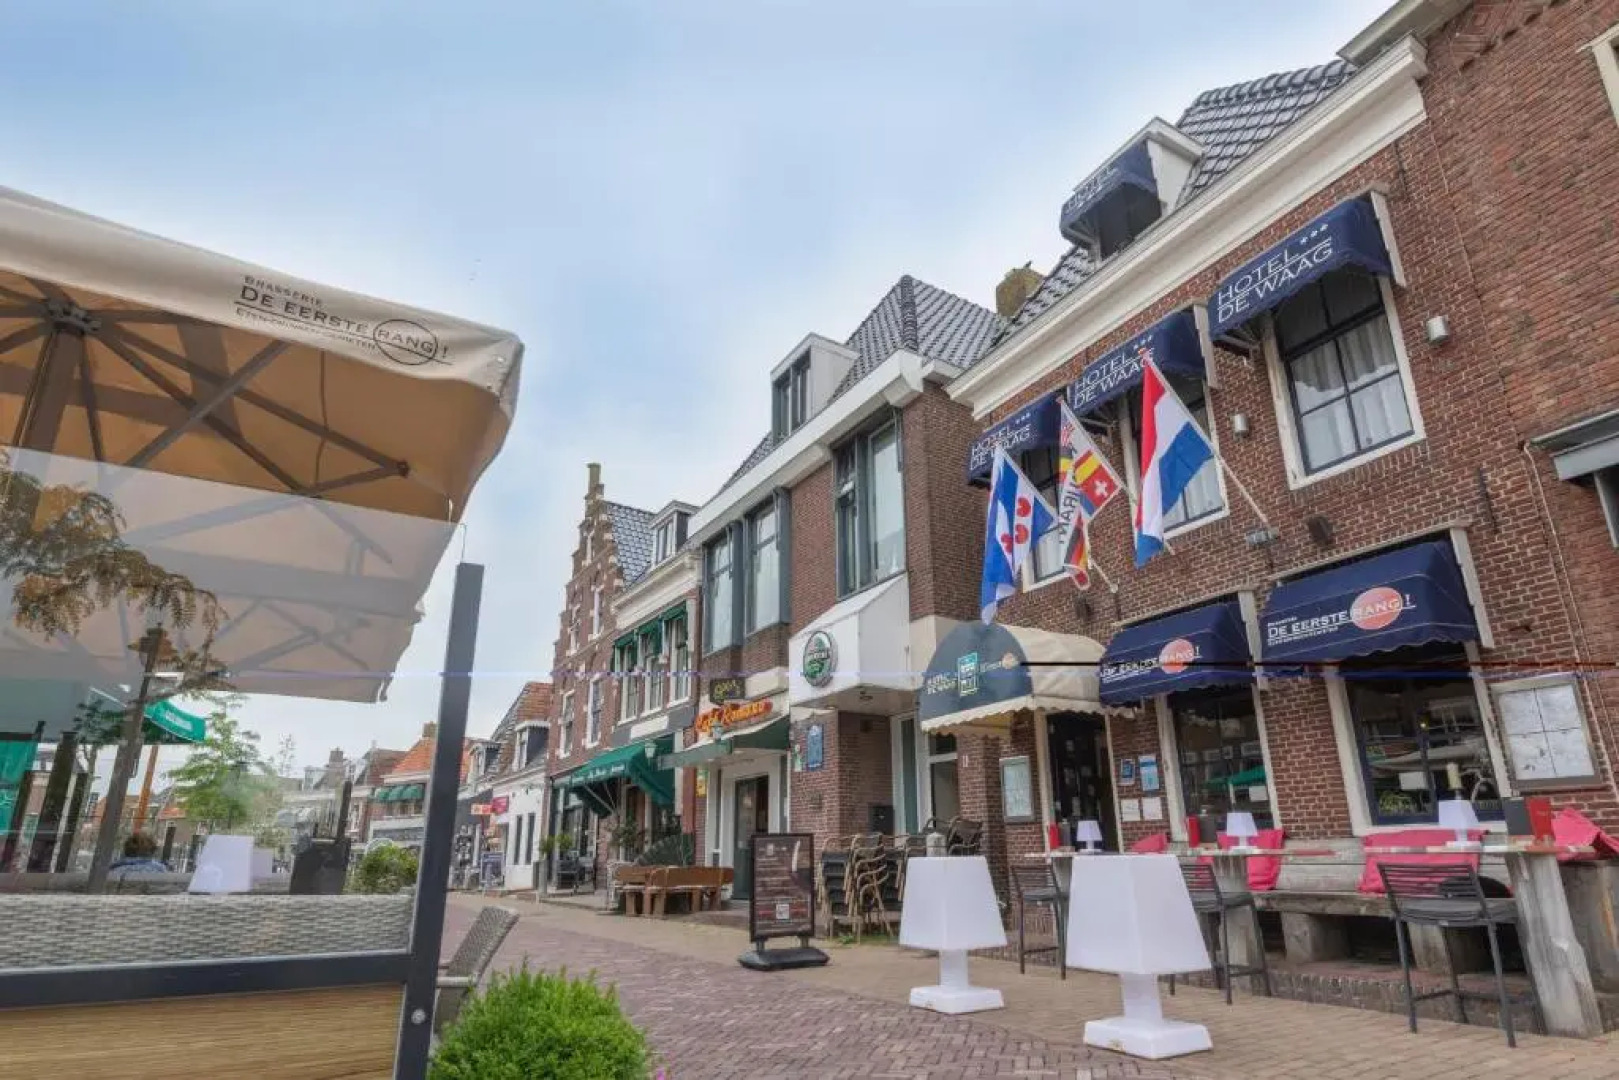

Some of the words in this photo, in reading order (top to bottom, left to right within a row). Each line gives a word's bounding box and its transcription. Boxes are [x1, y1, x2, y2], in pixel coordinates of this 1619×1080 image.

[1217, 248, 1299, 305] HOTEL
[1218, 291, 1250, 323] DE
[1255, 245, 1333, 299] WAAG
[241, 285, 273, 308] DE
[284, 300, 369, 334] EERSTE
[1074, 351, 1133, 393] HOTEL
[1074, 384, 1098, 410] DE
[1267, 625, 1288, 639] DE
[1292, 610, 1348, 634] EERSTE
